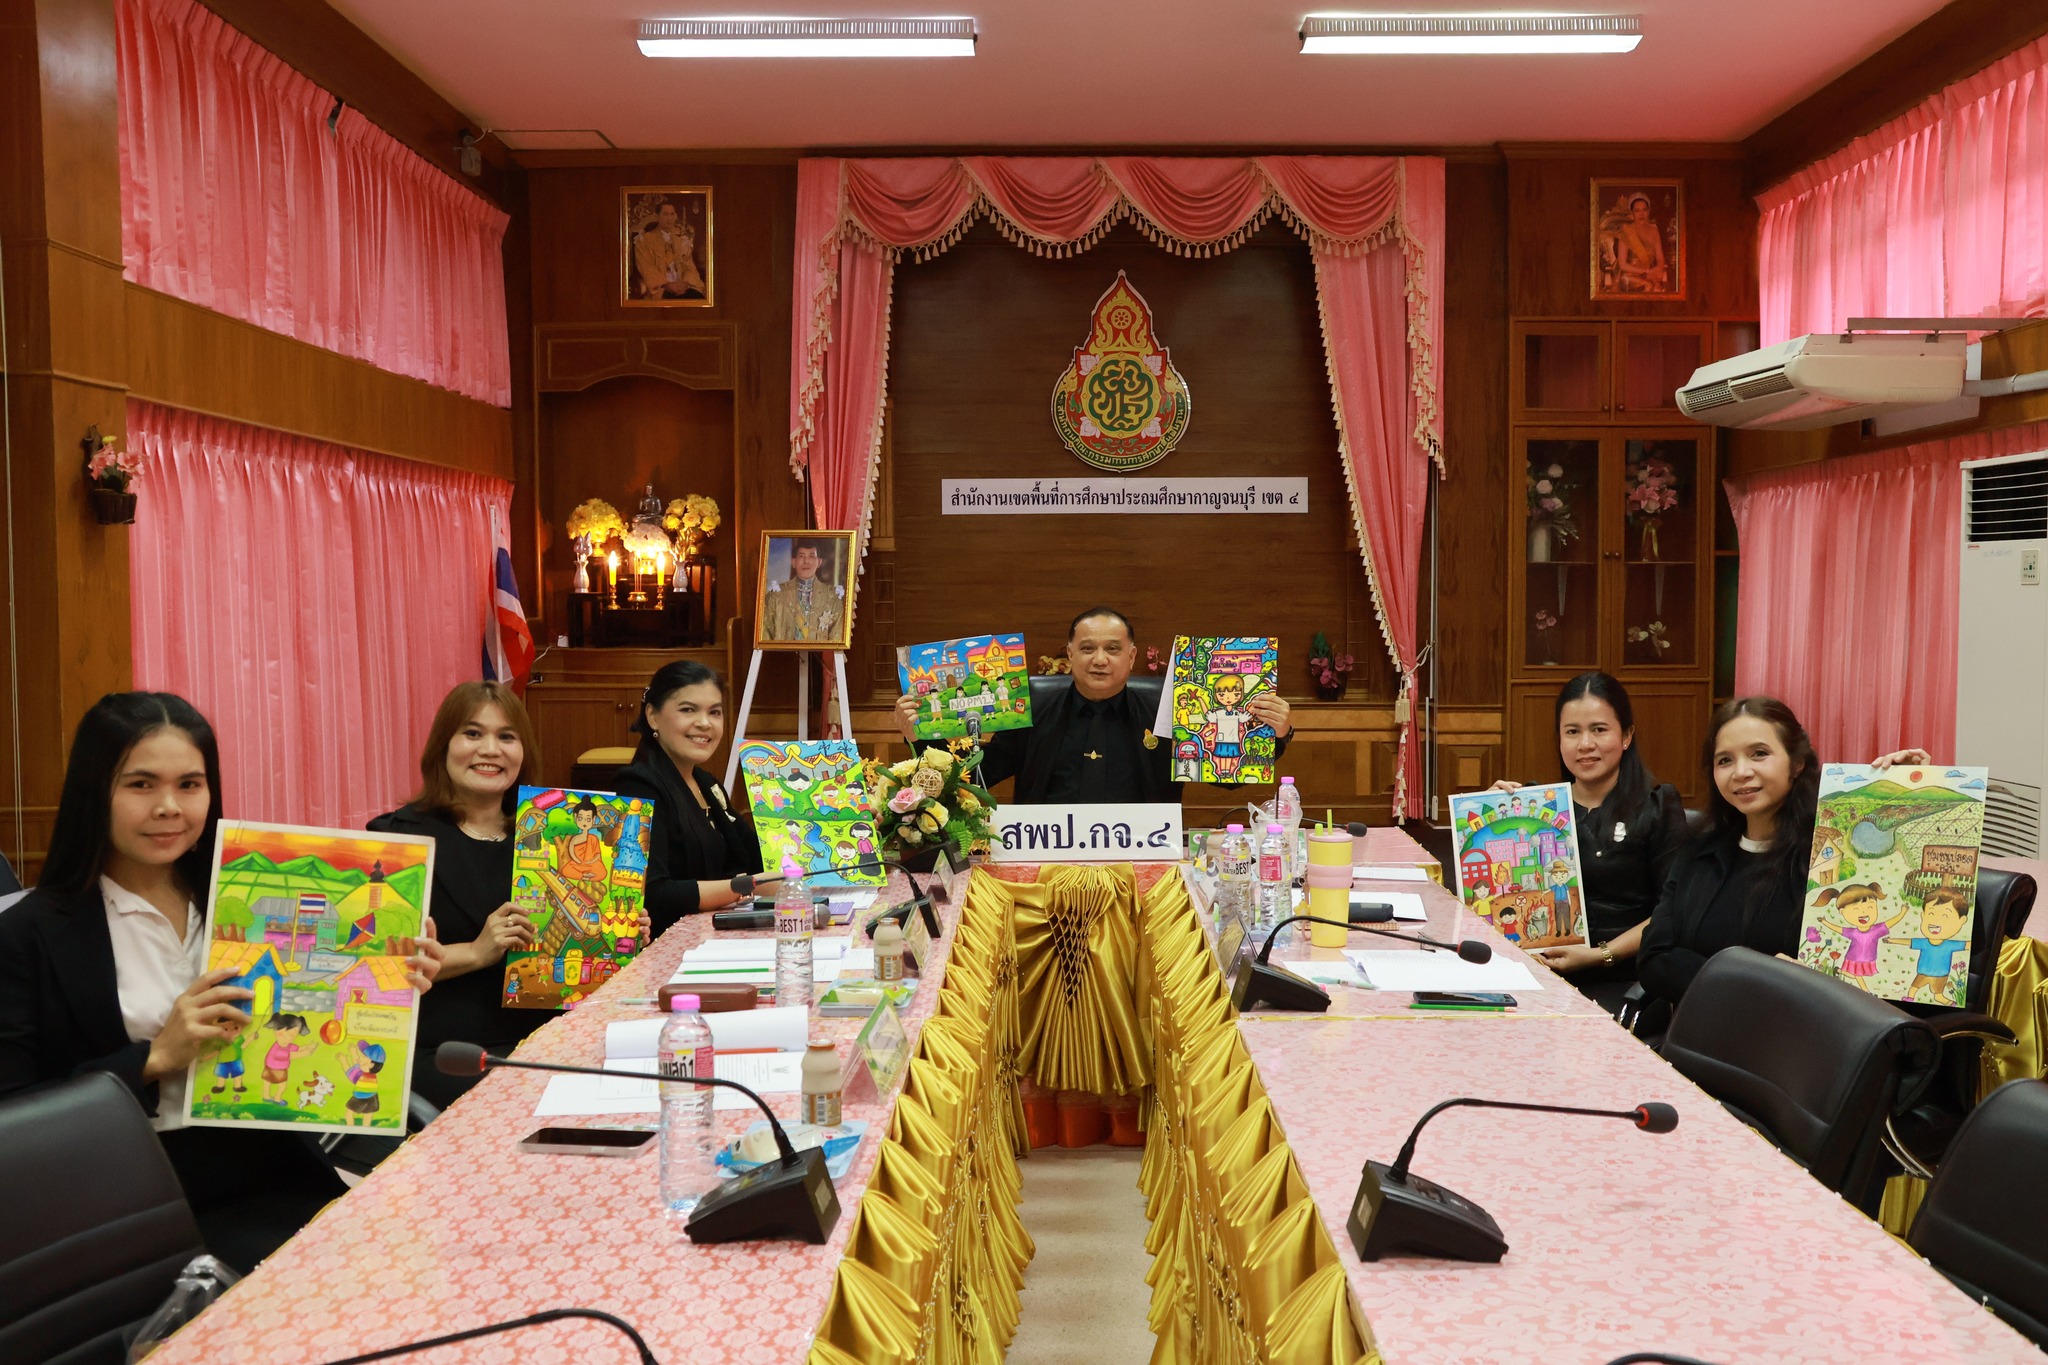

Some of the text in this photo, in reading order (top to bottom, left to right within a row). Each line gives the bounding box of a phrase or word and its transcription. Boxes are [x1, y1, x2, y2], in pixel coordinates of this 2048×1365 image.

[951, 481, 1299, 510] สำนักงานเขตพื้นที่การศึกษาประถมศึกษากาญจนบุรี เขต ๔
[951, 695, 995, 709] NO PM2.5
[1000, 814, 1171, 850] สพป.กจ.๔
[1235, 861, 1250, 875] BEST
[780, 918, 798, 933] BEST
[799, 918, 803, 932] 1
